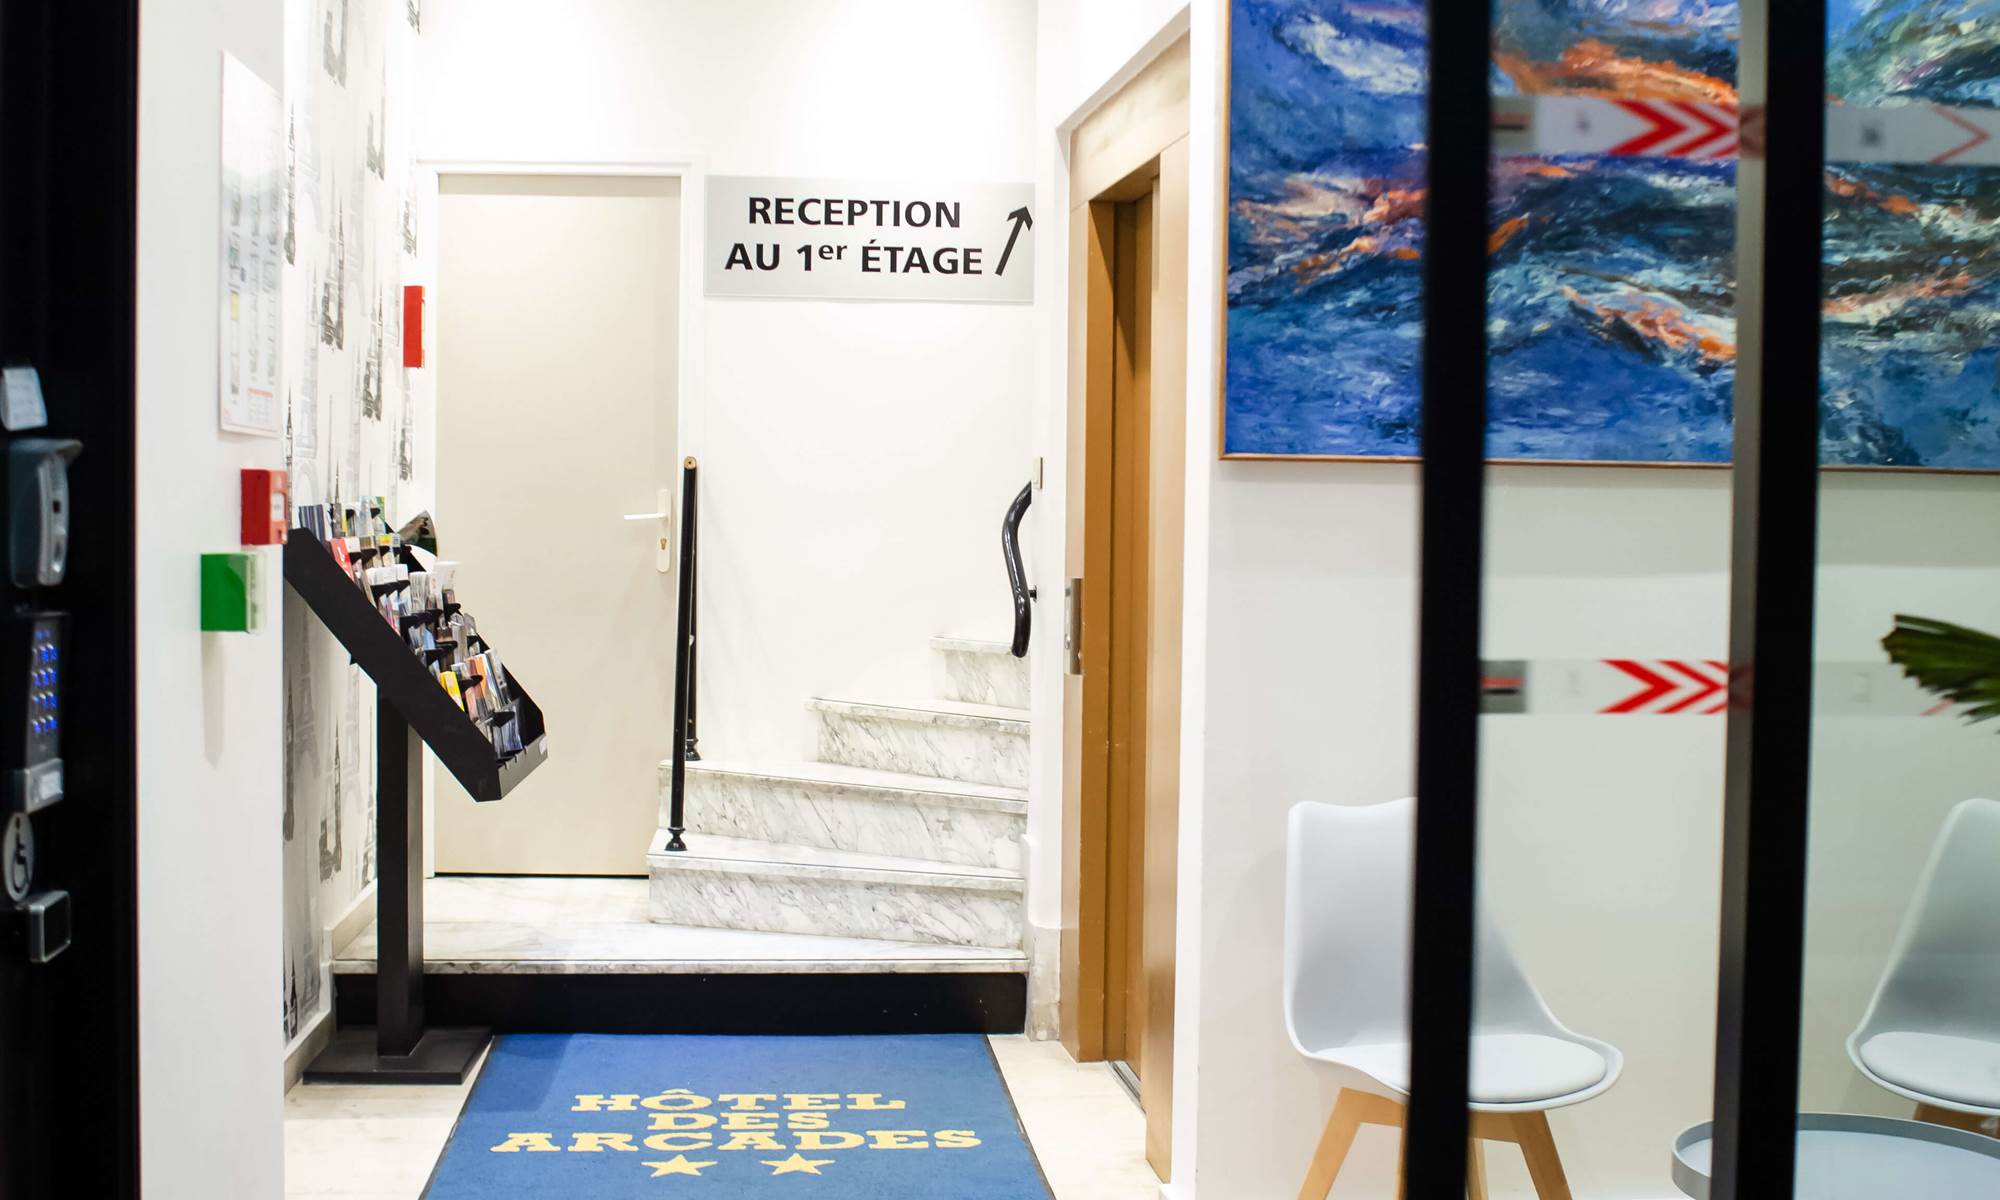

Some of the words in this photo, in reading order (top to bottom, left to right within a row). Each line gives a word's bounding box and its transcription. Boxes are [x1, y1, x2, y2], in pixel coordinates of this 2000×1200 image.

[748, 196, 960, 228] RECEPTION
[724, 242, 781, 271] AU
[796, 243, 848, 272] 1er
[861, 239, 983, 275] ÉTAGE
[571, 1089, 906, 1112] HÔTEL
[648, 1112, 830, 1131] DES
[491, 1130, 982, 1153] ARCADES
